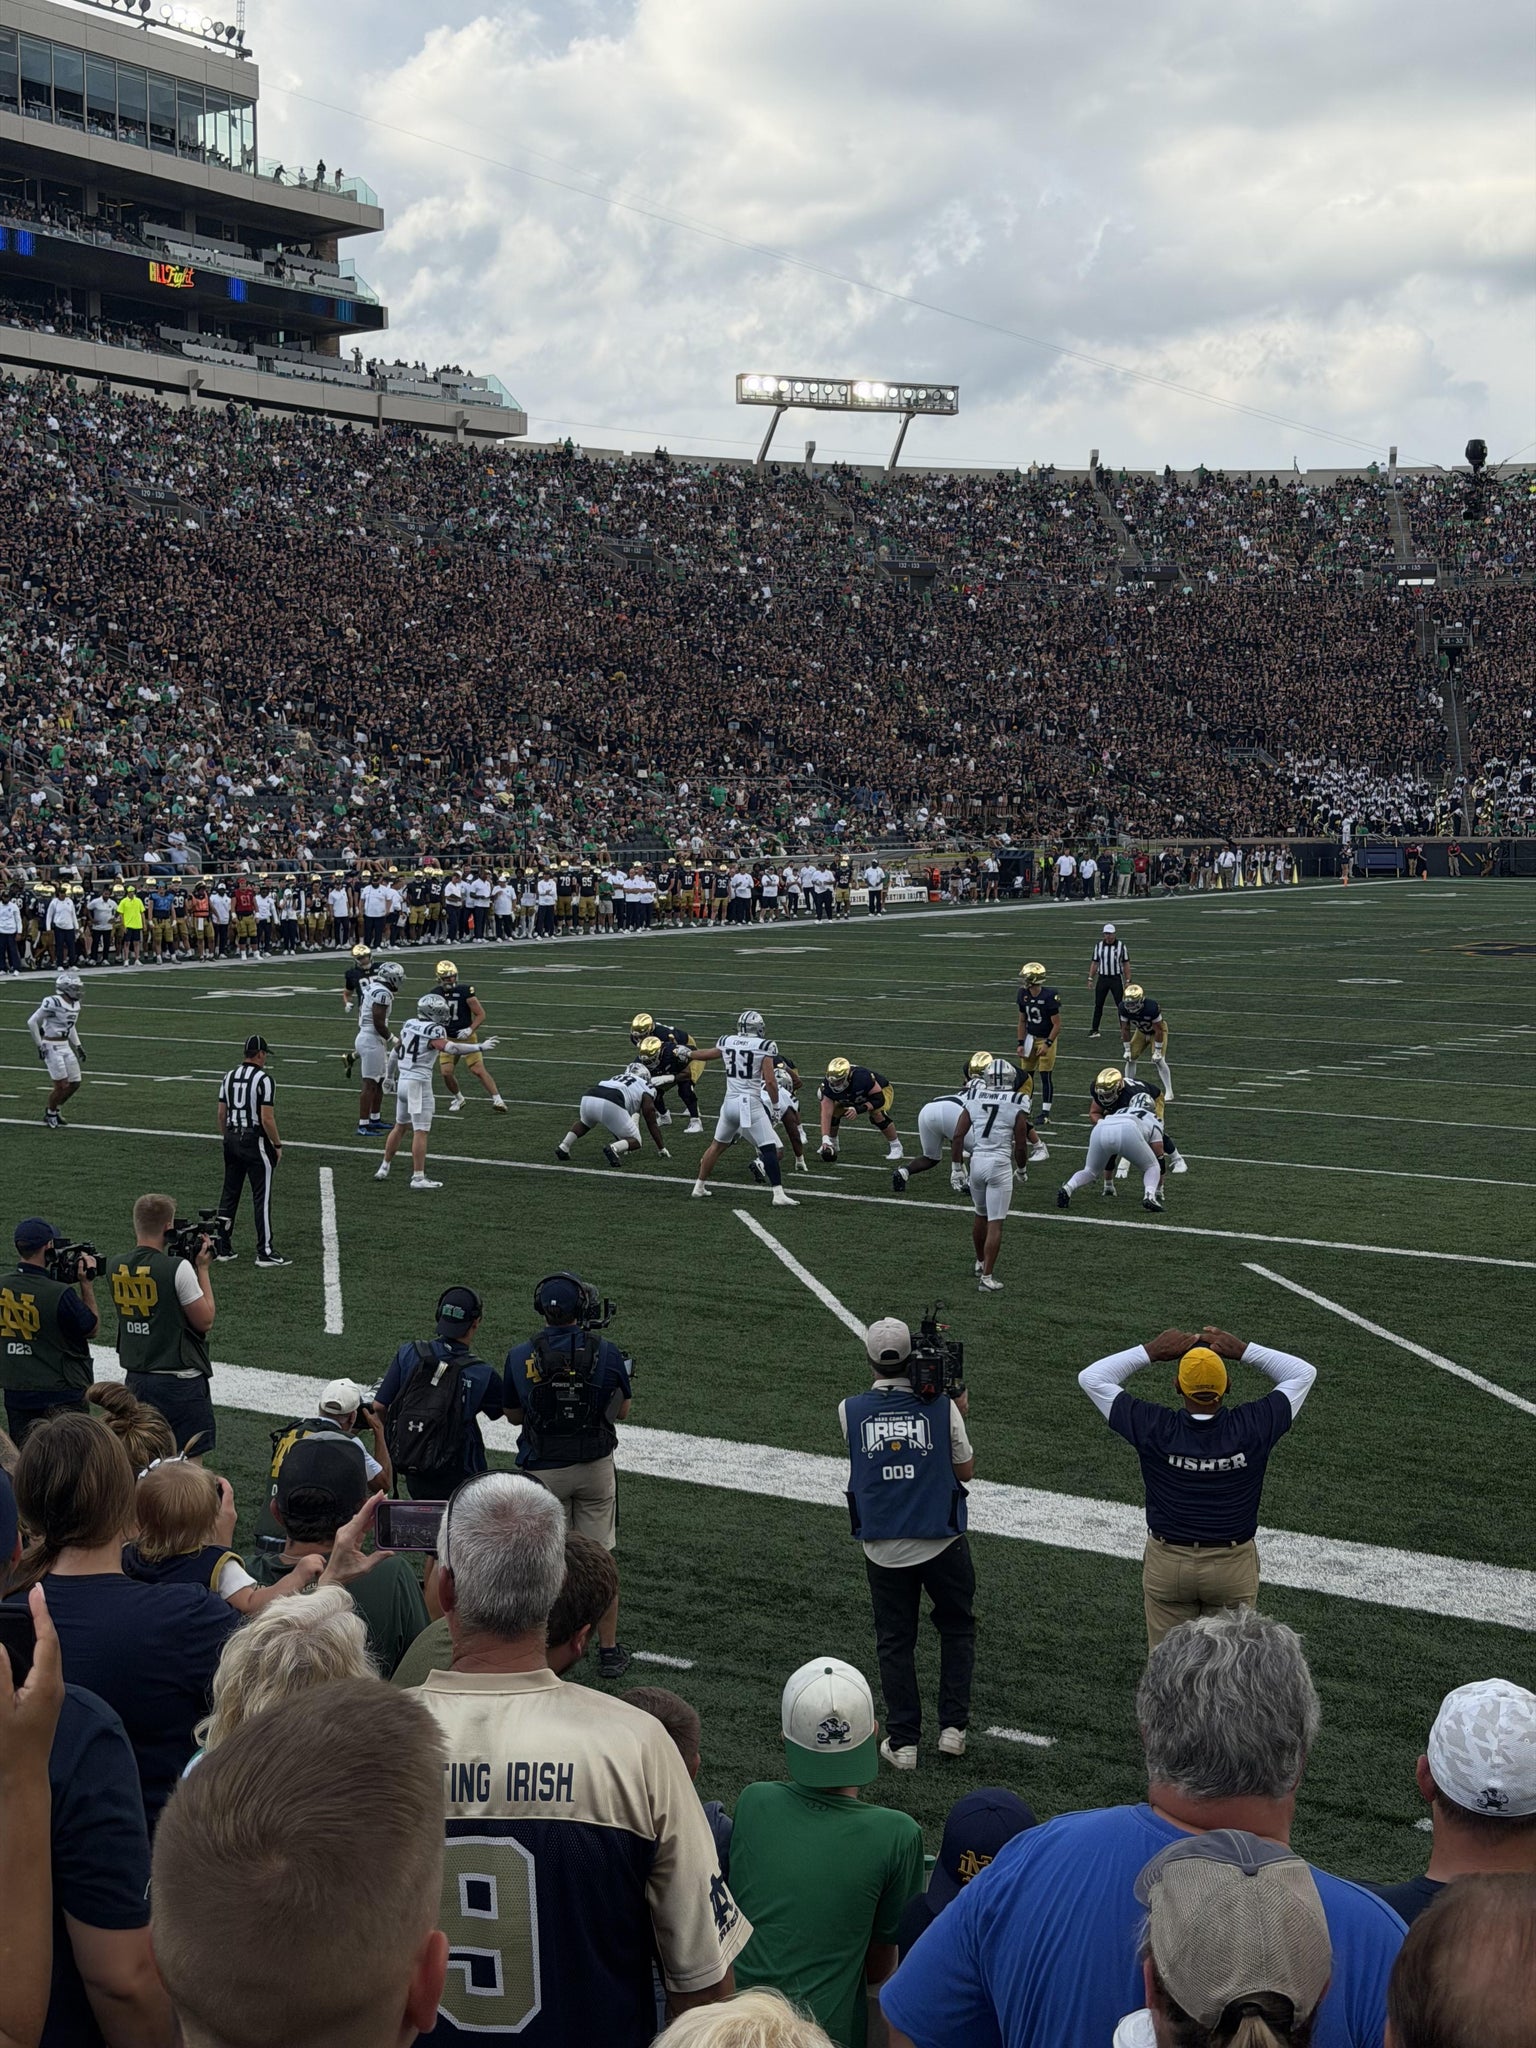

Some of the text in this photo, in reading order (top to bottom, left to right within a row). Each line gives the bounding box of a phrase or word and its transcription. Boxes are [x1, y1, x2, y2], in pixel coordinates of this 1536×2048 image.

[165, 264, 196, 289] Fight
[431, 883, 441, 895] 52
[581, 876, 592, 887] 65
[717, 879, 727, 889] 35
[173, 896, 185, 908] 39
[240, 895, 251, 906] 61
[415, 888, 422, 900] 7
[1025, 1005, 1043, 1024] 13
[725, 1048, 755, 1080] 33
[232, 1082, 248, 1109] U
[978, 1091, 1000, 1101] BROWN
[981, 1103, 1000, 1139] 7
[126, 1321, 150, 1335] 082
[7, 1342, 33, 1356] 023
[865, 1419, 927, 1452] IRISH
[1168, 1452, 1248, 1472] USHER
[882, 1464, 915, 1480] 009
[506, 1761, 575, 1803] IRISH
[437, 1835, 542, 2034] 9
